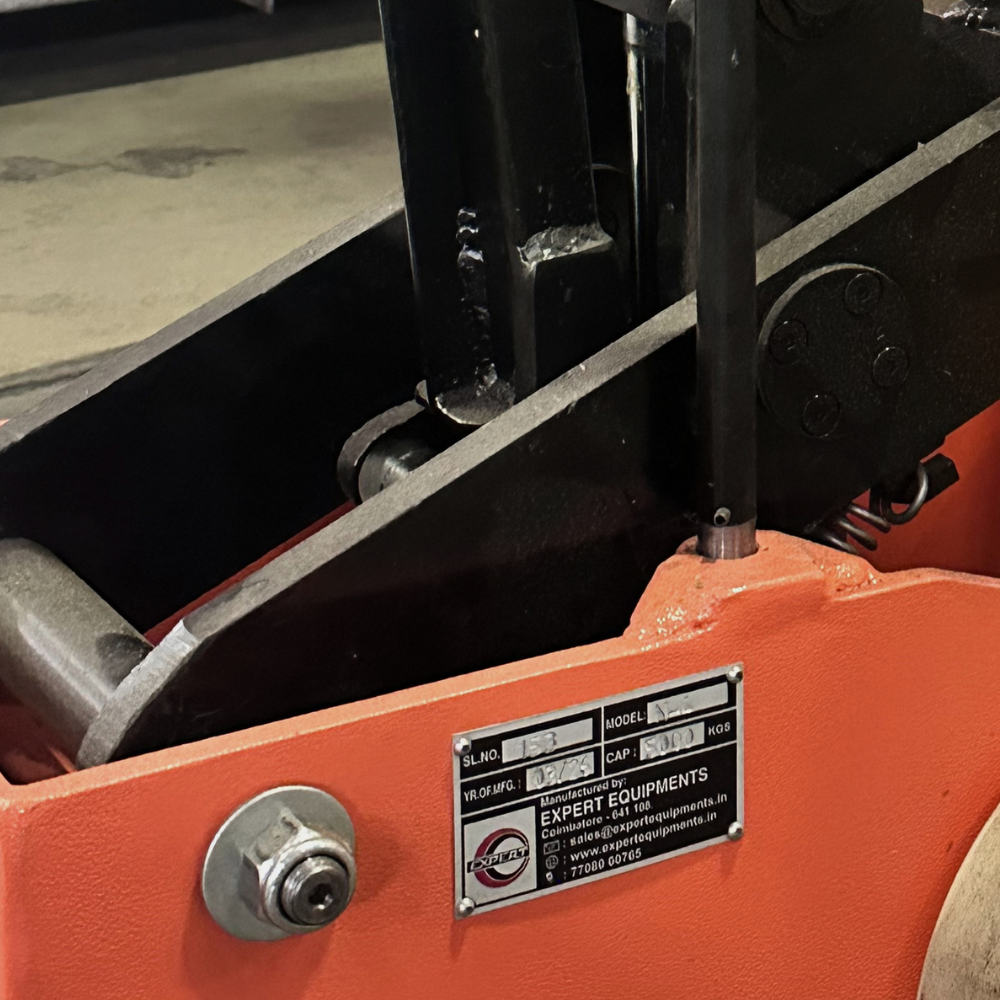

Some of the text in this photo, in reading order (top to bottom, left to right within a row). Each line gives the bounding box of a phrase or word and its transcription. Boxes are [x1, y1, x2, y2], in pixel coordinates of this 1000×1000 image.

[606, 710, 646, 730] MODEL:
[463, 749, 500, 768] SL.NO.
[540, 780, 609, 808] Manufactured
[541, 767, 708, 827] EXPERT EQUIPMENTS
